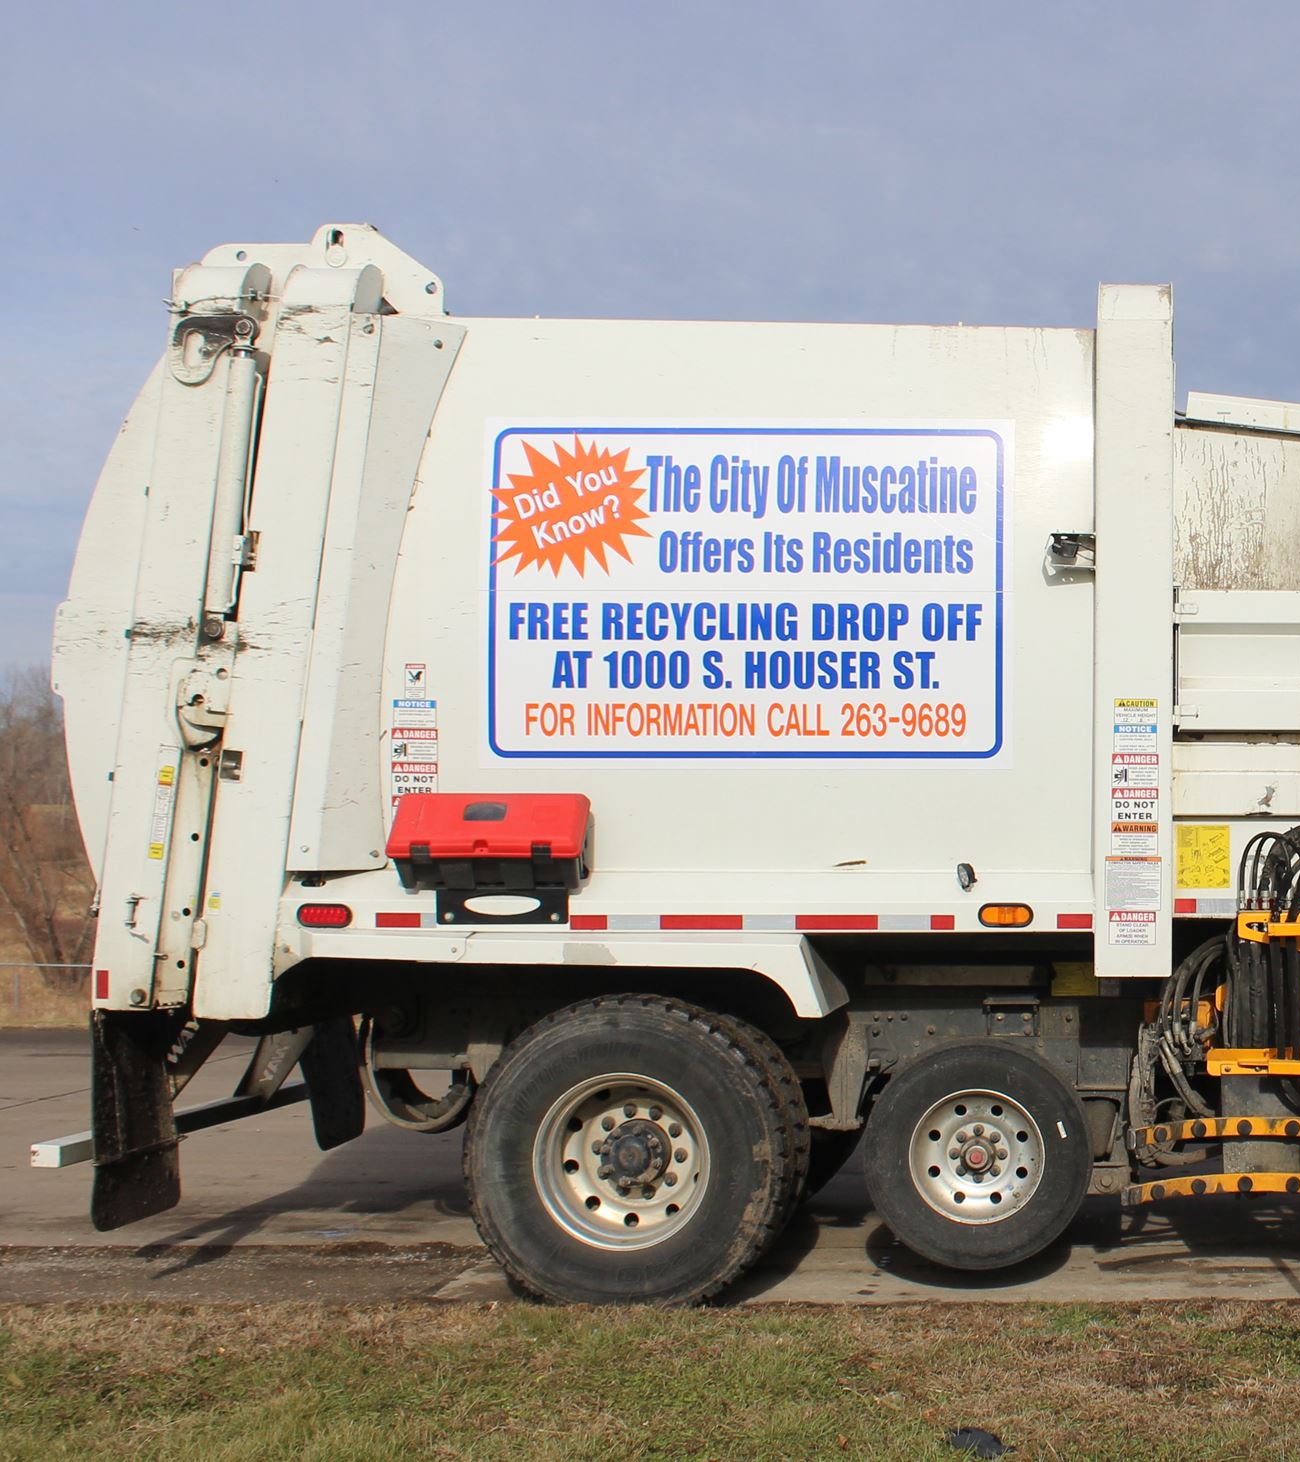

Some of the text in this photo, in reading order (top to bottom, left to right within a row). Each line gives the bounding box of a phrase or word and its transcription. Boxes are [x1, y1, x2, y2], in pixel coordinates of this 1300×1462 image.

[513, 465, 618, 520] Did You
[646, 455, 976, 518] The City Of Muscatine
[531, 494, 620, 550] Know?
[659, 531, 973, 573] Offers Its Residents
[508, 602, 983, 641] FREE RECYCLING DROP OFF
[553, 650, 939, 689] AT 1000 S. HOUSER ST.
[403, 730, 436, 738] DANGER
[526, 703, 967, 737] FOR INFORMATION CALL 263-9689
[403, 764, 436, 773] DANGER
[1124, 755, 1157, 764] DANGER
[395, 775, 435, 783] DO NOT
[1124, 789, 1157, 798] DANGER
[1121, 912, 1155, 921] DANGER
